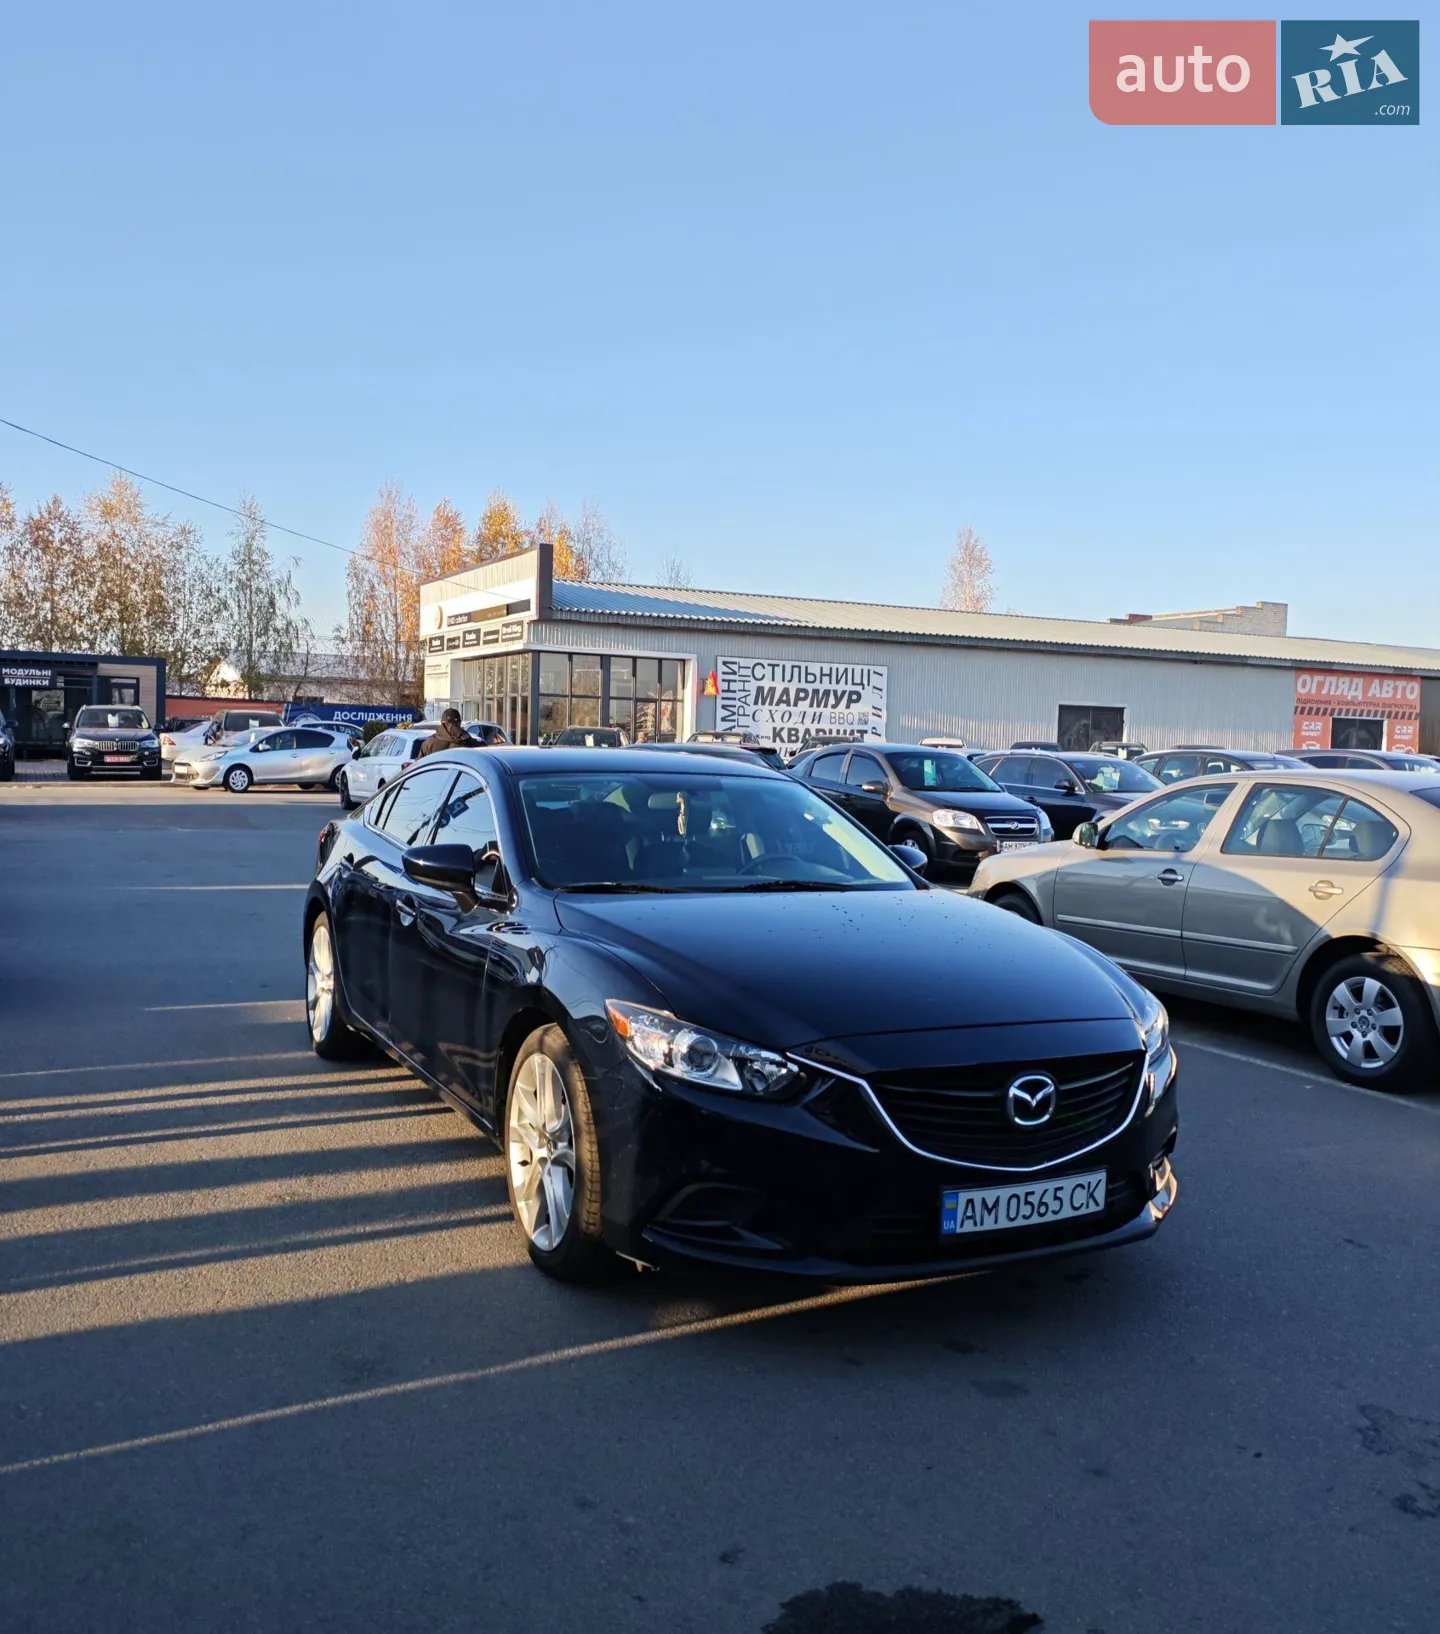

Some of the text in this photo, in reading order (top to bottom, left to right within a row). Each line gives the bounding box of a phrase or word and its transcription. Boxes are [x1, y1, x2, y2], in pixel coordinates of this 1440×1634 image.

[2, 668, 52, 676] МОДУЛЬНІ
[751, 662, 871, 690] СТІЛЬНИЦІ
[4, 678, 49, 686] БУДИНКИ
[1297, 674, 1419, 700] ОГЛЯД АВТО
[737, 661, 751, 728] ГРАНІТ
[753, 685, 862, 709] МАРМУР
[333, 711, 413, 723] ДОСЛІДЖЕННЯ
[752, 708, 823, 725] СХОДИ
[829, 711, 855, 725] BBQ
[959, 1179, 1102, 1229] AM 0565 CK
[943, 1220, 955, 1230] UA
